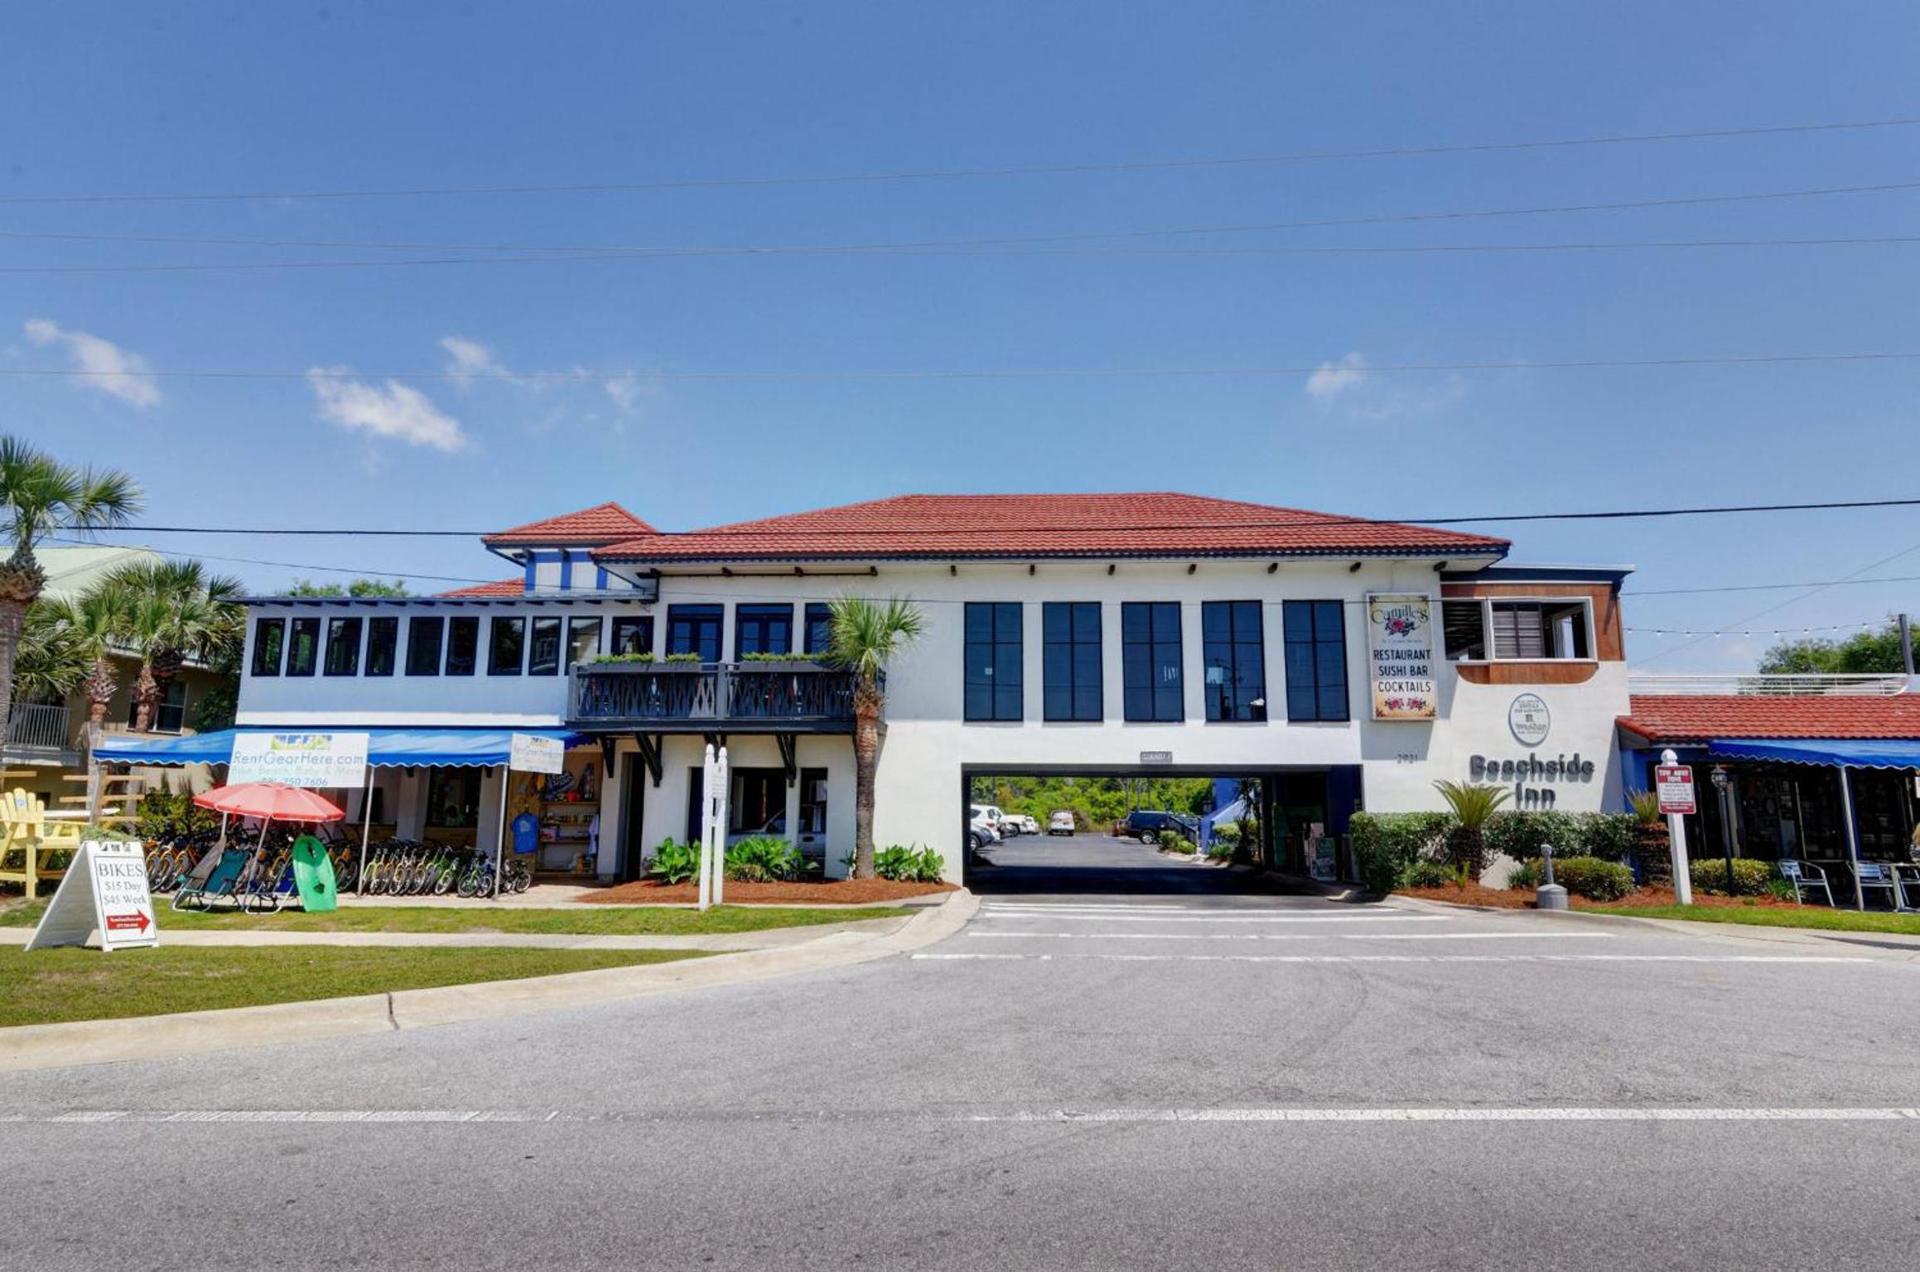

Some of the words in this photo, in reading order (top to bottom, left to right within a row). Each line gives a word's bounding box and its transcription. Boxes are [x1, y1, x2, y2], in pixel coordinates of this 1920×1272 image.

[1374, 649, 1431, 661] RESTAURANT
[1379, 665, 1407, 677] SUSHI
[1410, 665, 1428, 676] BAR
[1378, 681, 1432, 693] COCKTAILS
[233, 750, 364, 766] RentGearHere.com
[1470, 753, 1595, 777] Beachside
[1515, 782, 1556, 805] Inn
[98, 863, 144, 878] BIKES
[105, 881, 121, 891] $15
[124, 881, 142, 893] Day
[104, 896, 121, 905] $45
[123, 895, 147, 905] Week
